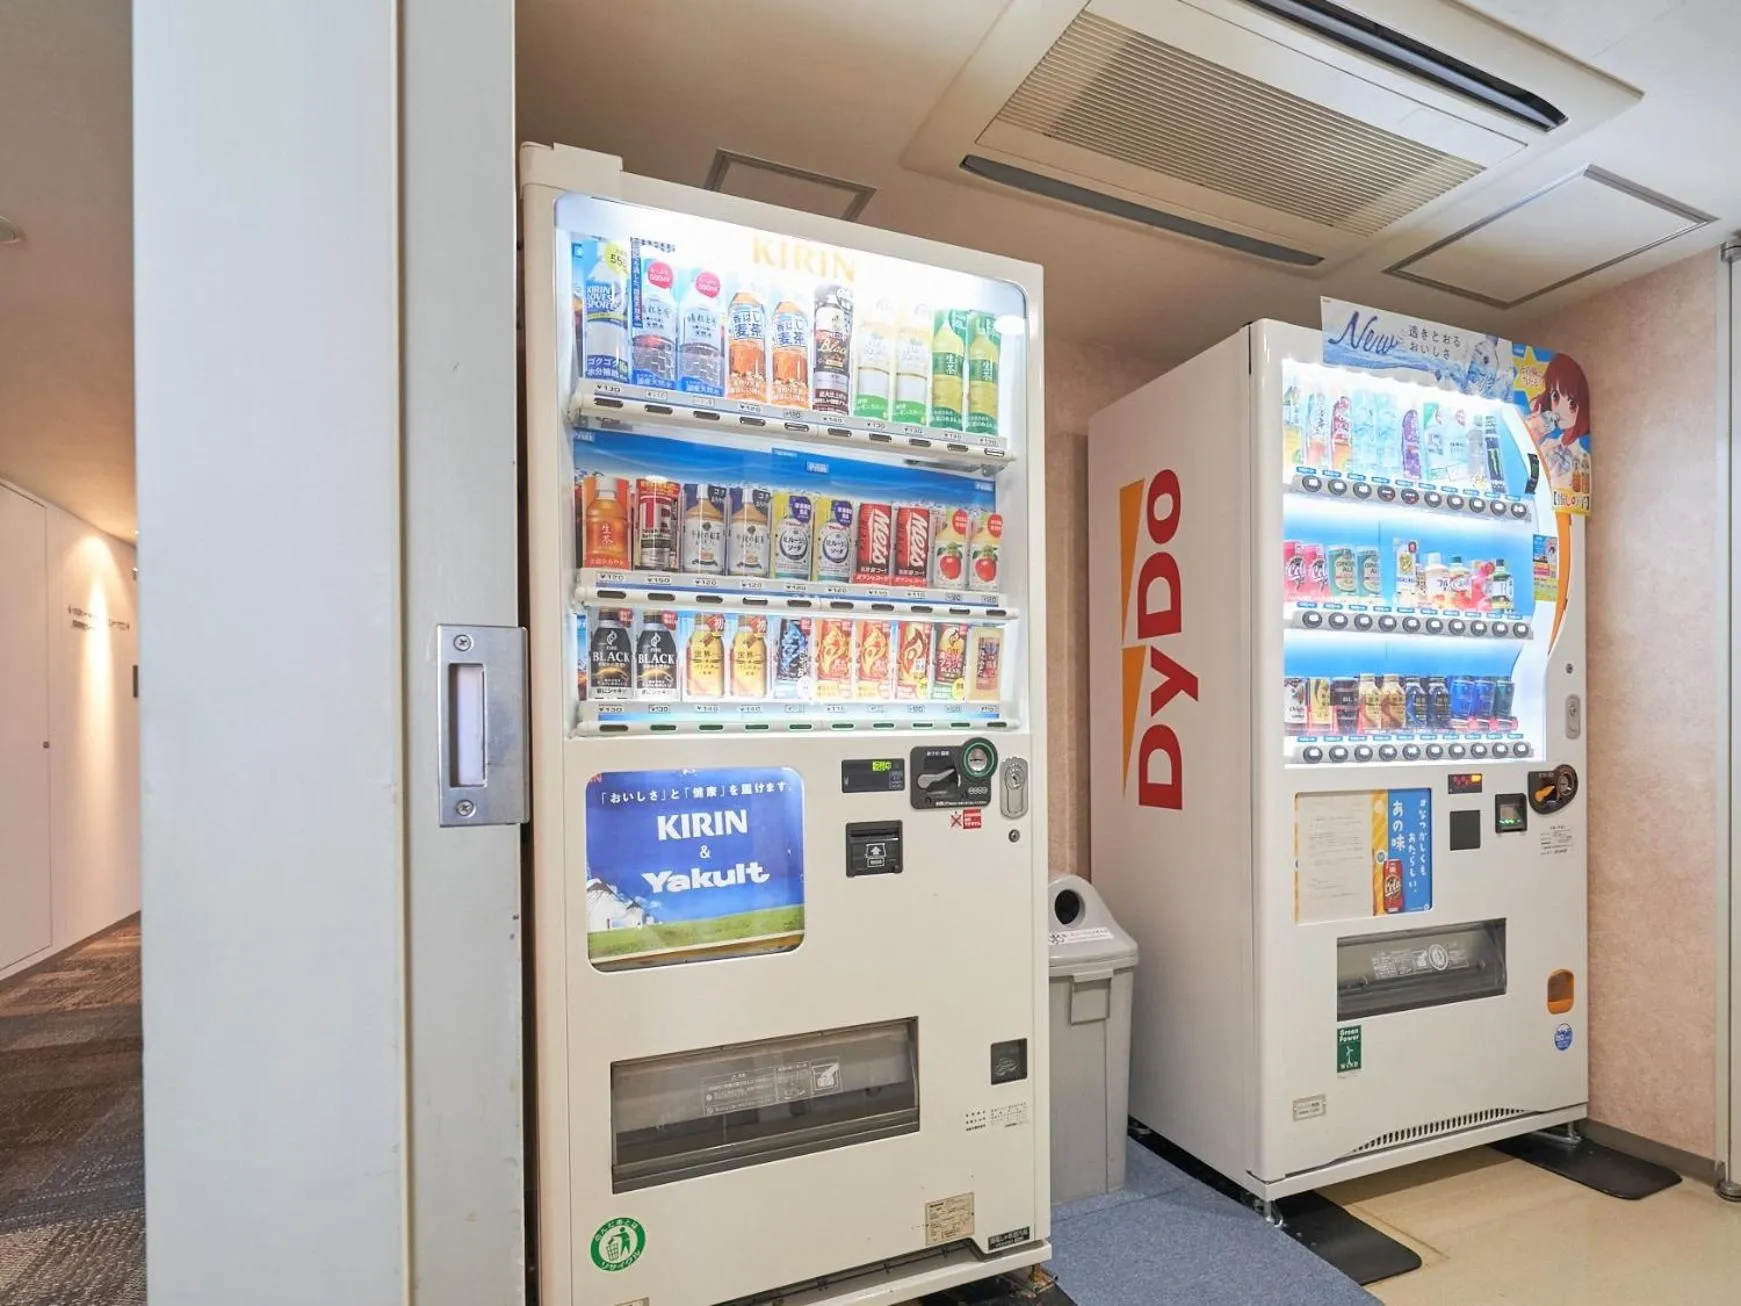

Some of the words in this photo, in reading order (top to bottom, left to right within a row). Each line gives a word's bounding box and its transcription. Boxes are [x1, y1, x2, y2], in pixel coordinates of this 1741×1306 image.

[753, 237, 855, 281] KIRIN
[1328, 310, 1399, 355] New
[1409, 324, 1461, 348] 透きとおる
[1410, 341, 1450, 360] おいしさ
[592, 651, 630, 663] BLACK
[638, 653, 675, 665] BLACK
[657, 809, 748, 841] KIRIN
[1391, 800, 1406, 852] あの味
[699, 844, 711, 859] &
[641, 862, 770, 893] Yakult
[1340, 1028, 1359, 1036] Green
[1340, 1034, 1360, 1042] Power
